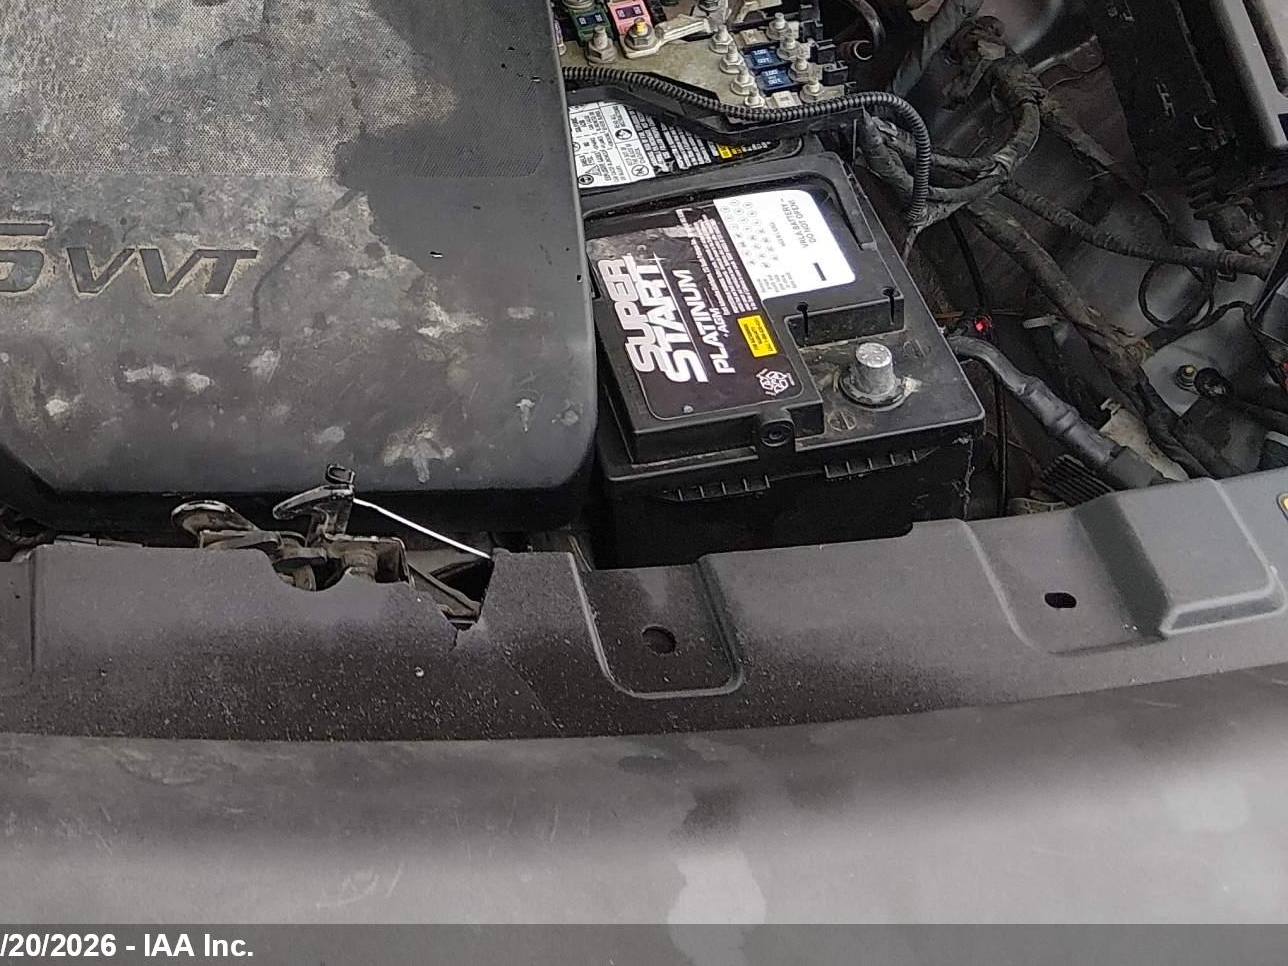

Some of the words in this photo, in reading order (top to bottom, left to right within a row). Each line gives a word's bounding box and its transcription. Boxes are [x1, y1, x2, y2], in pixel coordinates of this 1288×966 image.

[780, 204, 801, 230] BATTERY
[798, 220, 811, 233] NOT
[805, 233, 817, 243] DO
[65, 247, 259, 297] VVT
[597, 258, 666, 372] SUPER
[622, 253, 709, 382] START
[672, 269, 736, 374] PLATINUM
